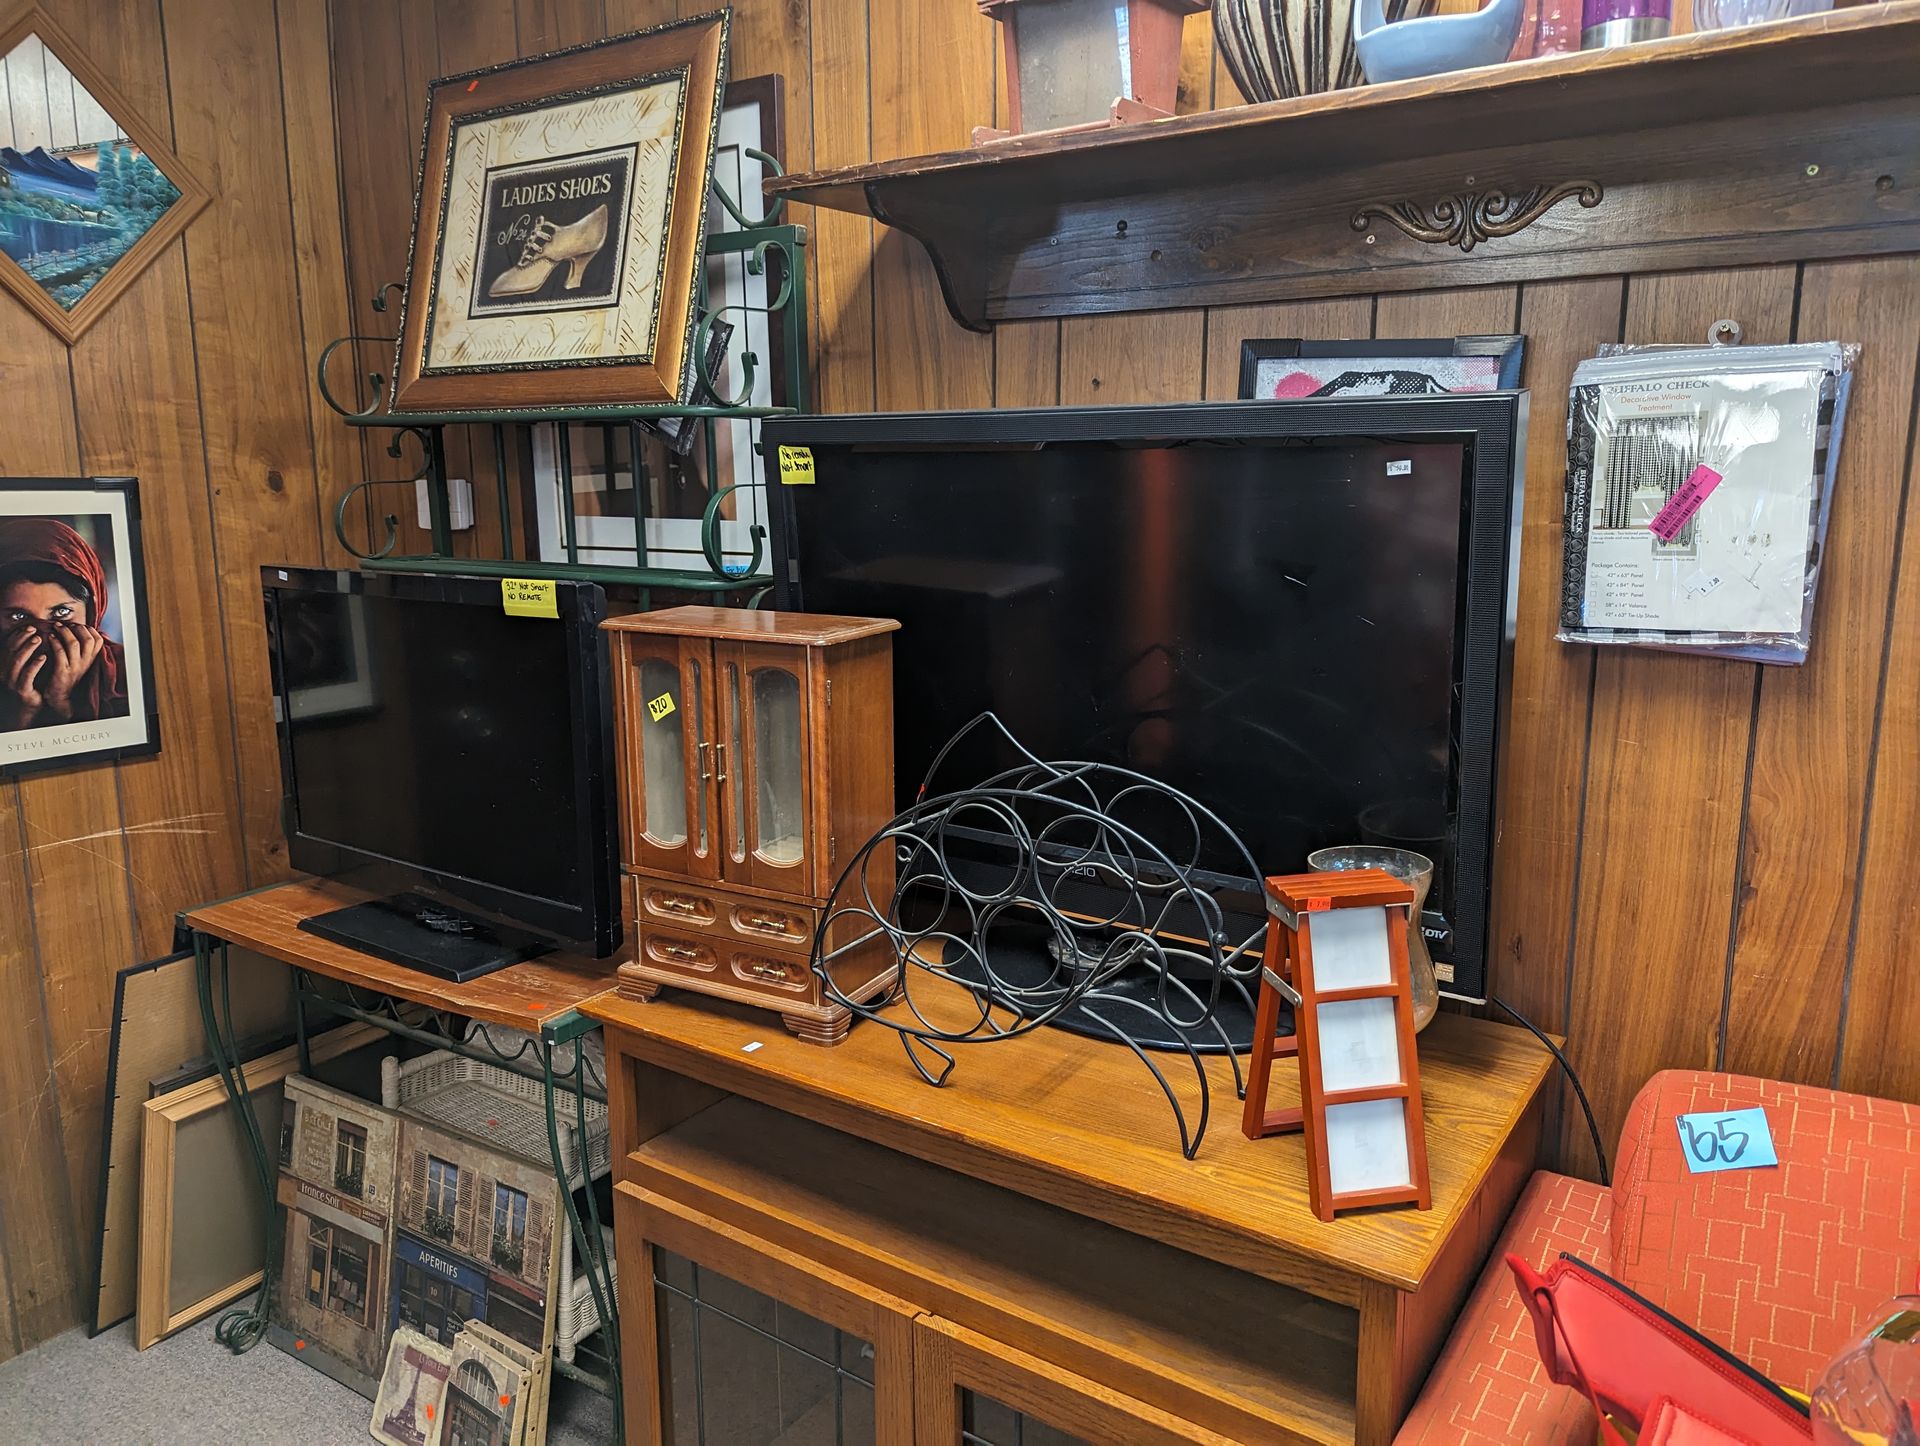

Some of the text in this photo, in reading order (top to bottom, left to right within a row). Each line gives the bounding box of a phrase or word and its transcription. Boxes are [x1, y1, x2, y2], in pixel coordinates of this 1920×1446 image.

[501, 173, 612, 208] LADIES SHOES
[1666, 379, 1710, 391] CHECK
[1661, 393, 1692, 401] Window
[1637, 403, 1673, 412] Treatment
[781, 461, 793, 472] Not
[1575, 469, 1587, 534] BUFFALO CHECK
[519, 581, 529, 590] Not
[530, 582, 549, 592] Smart
[519, 592, 542, 601] REMOTE
[650, 697, 668, 714] $20
[8, 740, 45, 753] STEVE
[418, 1250, 458, 1279] APERITIFS
